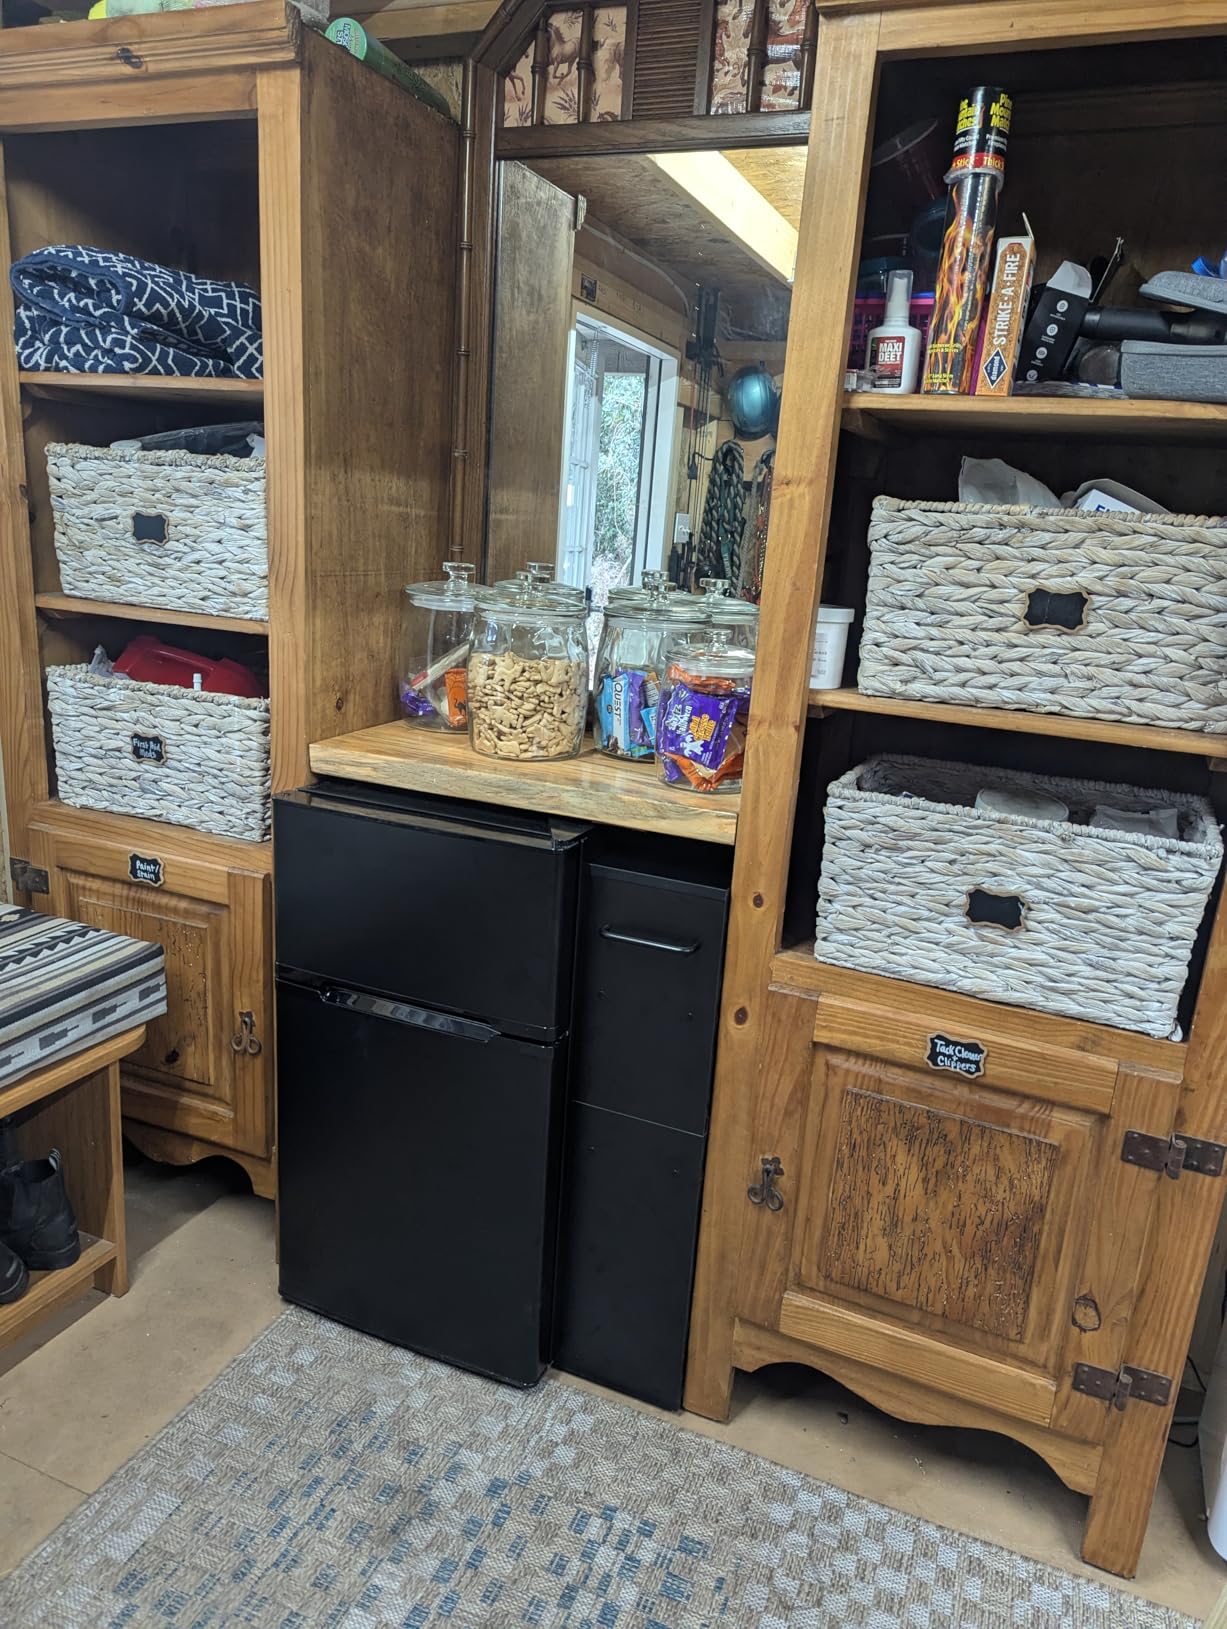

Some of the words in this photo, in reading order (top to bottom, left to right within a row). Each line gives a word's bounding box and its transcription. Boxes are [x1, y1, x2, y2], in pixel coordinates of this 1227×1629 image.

[879, 342, 903, 352] MAXI
[878, 352, 902, 362] DEET
[990, 355, 1001, 380] diamond
[614, 682, 623, 718] QUEST
[133, 738, 149, 749] First
[934, 1039, 955, 1055] Tack
[937, 1055, 976, 1072] Clippers
